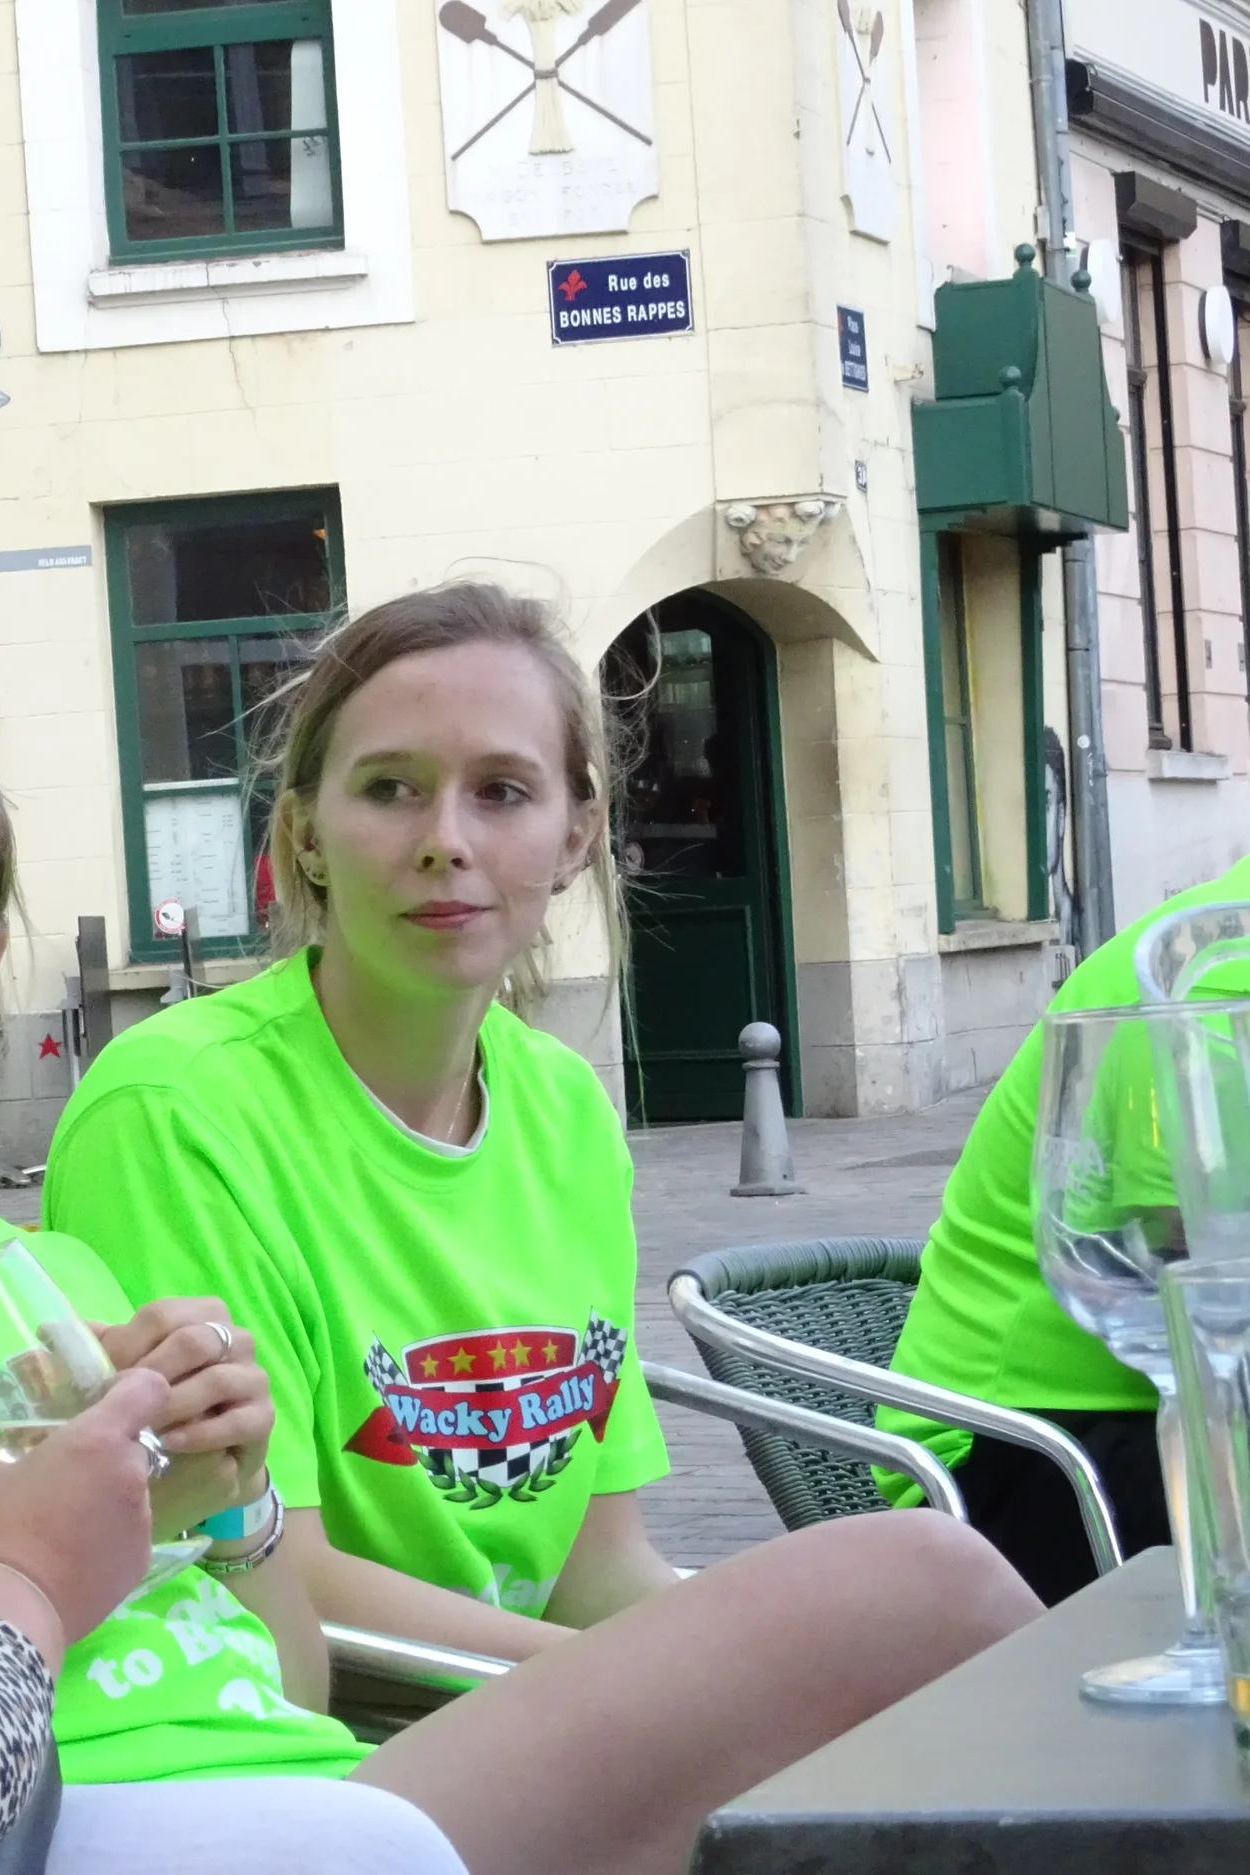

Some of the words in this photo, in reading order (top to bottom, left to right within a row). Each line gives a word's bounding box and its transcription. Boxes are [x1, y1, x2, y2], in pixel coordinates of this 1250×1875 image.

[1199, 17, 1250, 126] PAR
[608, 274, 637, 292] Rue
[643, 272, 670, 289] des
[559, 306, 622, 328] BONNES
[627, 301, 686, 322] RAPPES
[387, 1393, 512, 1443] Wacky
[518, 1373, 595, 1430] Rally
[86, 1648, 164, 1700] to
